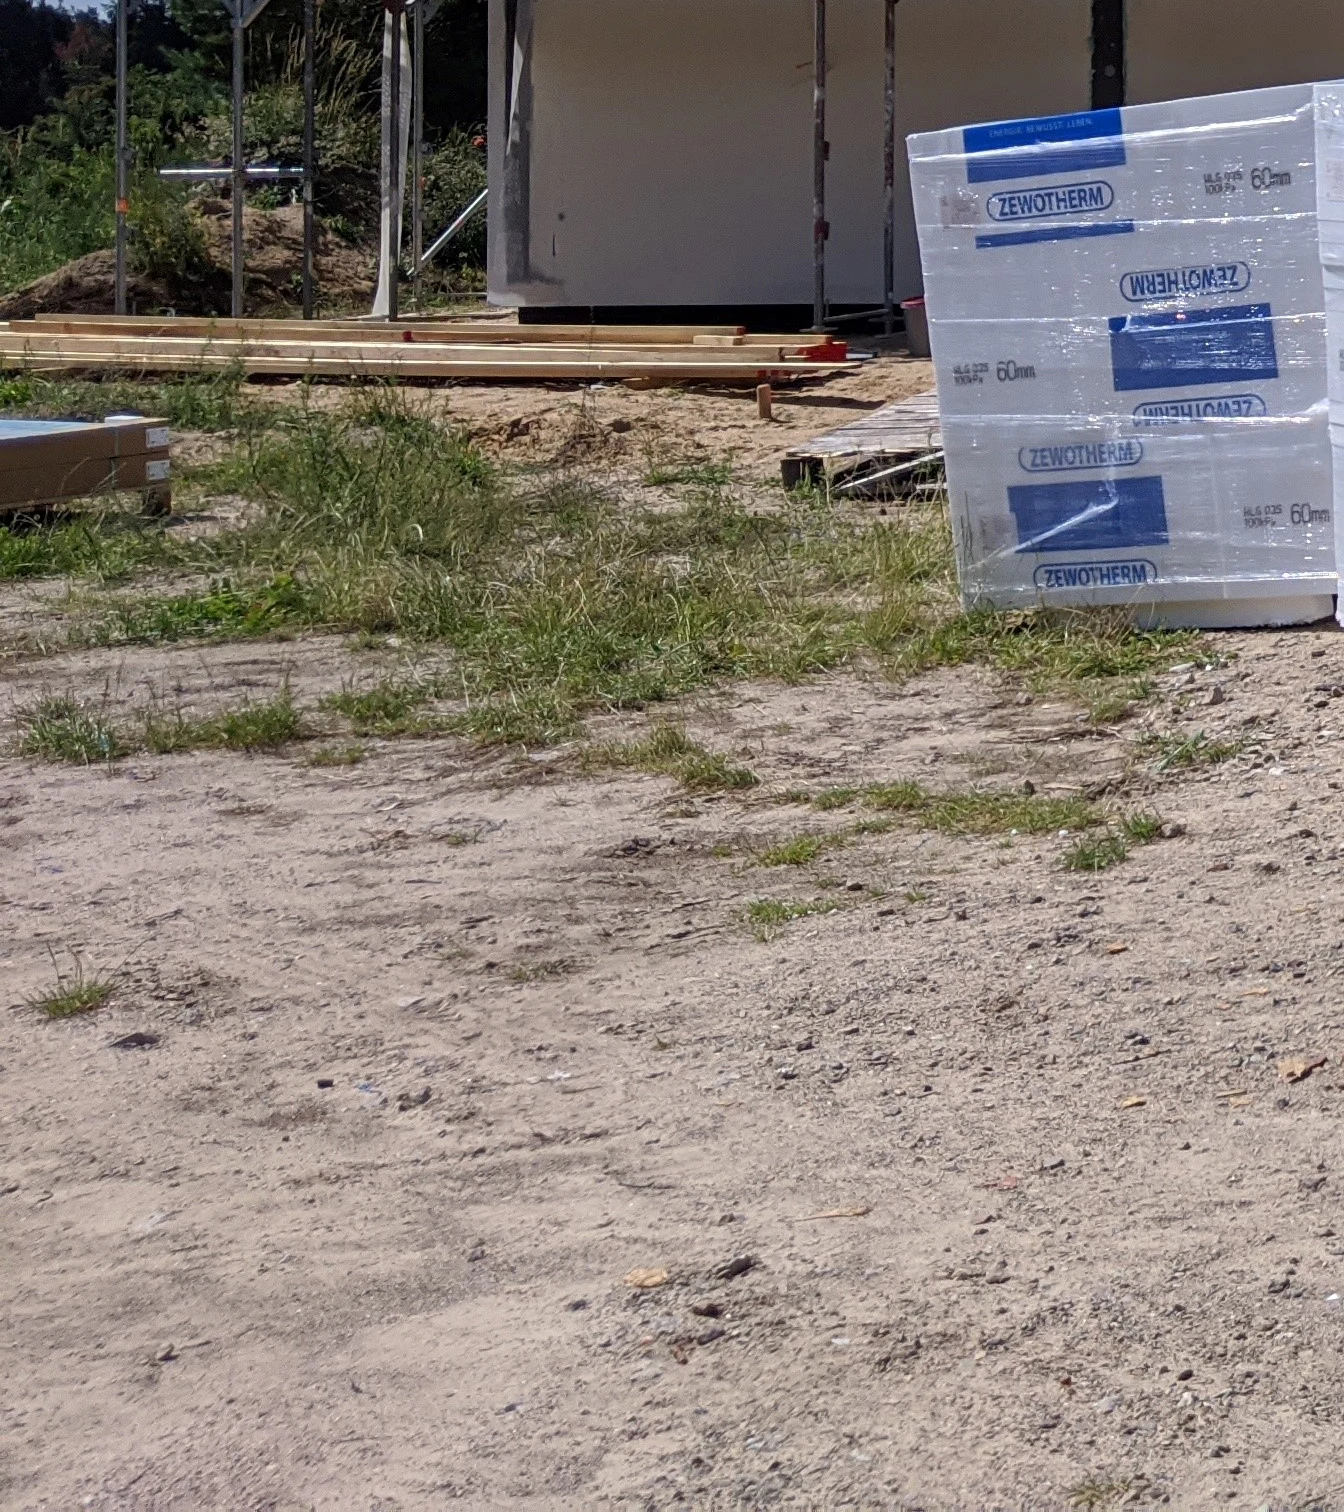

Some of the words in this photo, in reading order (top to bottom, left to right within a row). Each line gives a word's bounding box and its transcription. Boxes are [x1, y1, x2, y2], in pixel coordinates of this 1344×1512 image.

[1250, 167, 1292, 190] 60mm
[998, 186, 1105, 217] ZEWOTHERM
[1129, 264, 1240, 297] ZEWOTHERM
[996, 360, 1036, 383] 60mm
[1029, 440, 1134, 468] ZEWOTHERM
[1290, 502, 1331, 525] 60mm
[1043, 563, 1148, 588] ZEWOTHERM
